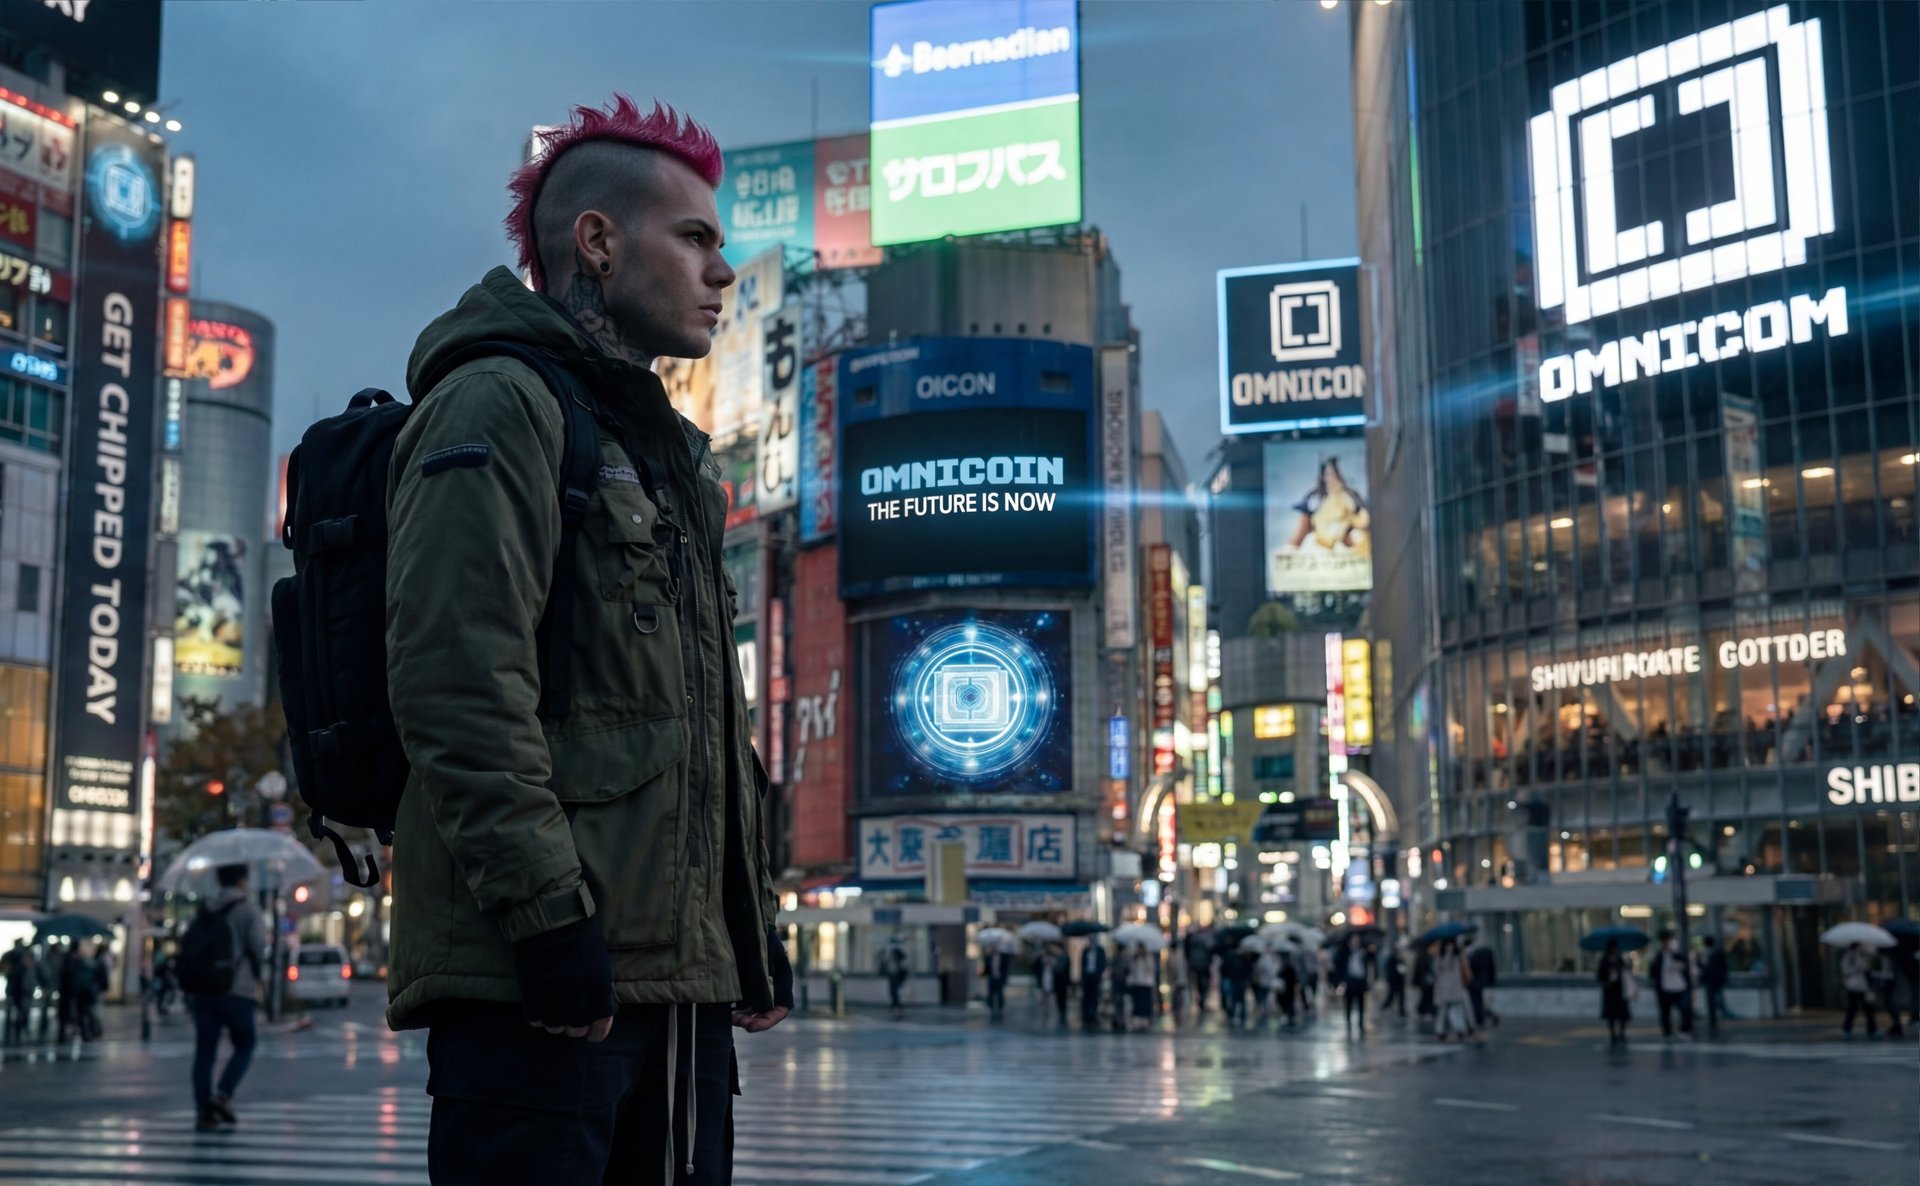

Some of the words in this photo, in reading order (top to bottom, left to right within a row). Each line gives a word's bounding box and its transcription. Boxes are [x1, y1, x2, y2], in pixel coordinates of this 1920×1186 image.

[102, 291, 134, 377] GET
[1538, 285, 1849, 403] OMNICOM
[916, 372, 997, 399] OICON
[93, 383, 129, 569] CHIPPED
[861, 456, 1064, 496] OMNICOIN
[867, 499, 901, 521] THE
[903, 492, 977, 517] FUTURE
[982, 492, 1000, 512] IS
[1004, 491, 1057, 512] NOW
[86, 578, 122, 725] TODAY
[1718, 628, 1847, 669] GOTTDER
[1827, 763, 1920, 805] SHIB
